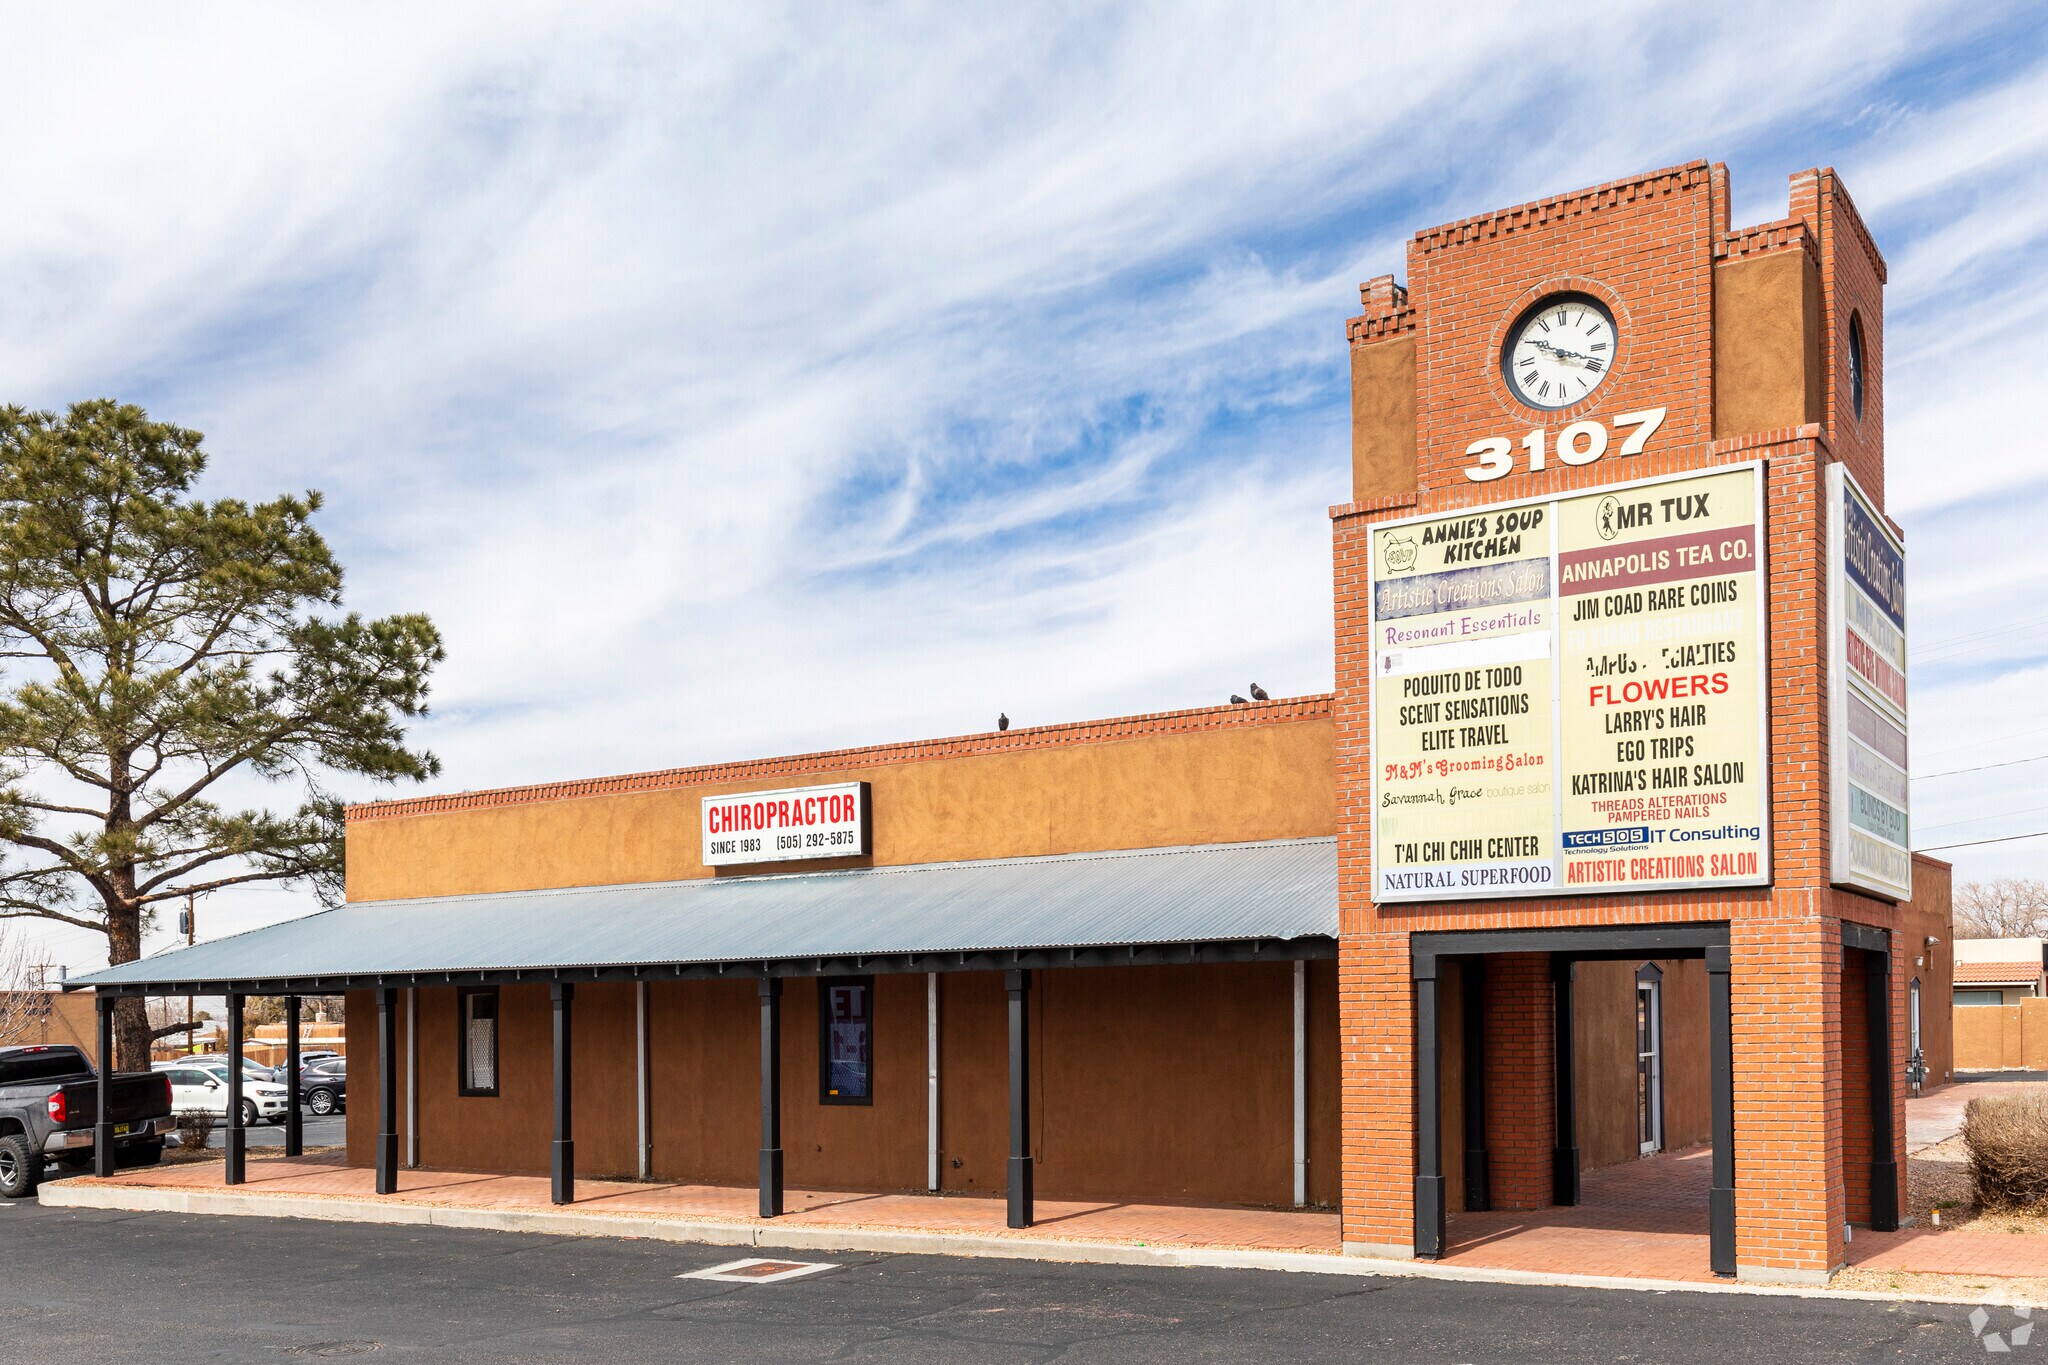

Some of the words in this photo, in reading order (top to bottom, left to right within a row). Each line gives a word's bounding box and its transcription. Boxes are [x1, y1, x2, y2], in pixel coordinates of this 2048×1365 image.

[1464, 407, 1667, 482] 3107
[1617, 502, 1653, 530] MR
[1660, 493, 1710, 522] TUX
[1422, 517, 1488, 546] ANNIE'S
[1495, 509, 1544, 536] SOUP
[1443, 535, 1521, 564] KITCHEN
[1562, 550, 1670, 583] ANNAPOLIS
[1676, 544, 1713, 567] TEA
[1720, 539, 1752, 562] CO.
[1380, 583, 1433, 613] Artistic
[1437, 578, 1502, 605] Creations
[1506, 564, 1546, 597] Salon
[1573, 598, 1599, 621] JIM
[1604, 592, 1643, 617] COAD
[1648, 587, 1685, 611] RARE
[1690, 580, 1737, 607] COINS
[1385, 620, 1455, 645] Resonant
[1460, 609, 1541, 635] Essentials
[1404, 672, 1461, 698] POQUITO
[1465, 670, 1481, 691] DE
[1485, 665, 1522, 689] TODO
[1590, 672, 1729, 706] FLOWERS
[1400, 702, 1441, 726] SCENT
[1445, 693, 1529, 722] SENSATIONS
[1605, 708, 1664, 734] LARRY'S
[1670, 704, 1706, 728] HAIR
[1422, 729, 1455, 751] ELITE
[1460, 724, 1509, 748] TRAVEL
[1617, 740, 1645, 762] EGO
[1650, 735, 1694, 759] TRIPS
[1385, 759, 1433, 782] M&M's
[1572, 769, 1646, 796] KATRINA'S
[1652, 766, 1688, 789] HAIR
[1693, 761, 1744, 786] SALON
[1382, 789, 1445, 808] Savannah
[1449, 786, 1483, 805] Grace
[1486, 784, 1525, 798] boutique
[1527, 782, 1551, 795] salon
[1592, 798, 1644, 812] THREADS
[1648, 792, 1727, 809] ALTERATIONS
[709, 794, 855, 834] CHIROPRACTOR
[1608, 808, 1670, 823] PAMPERED
[1675, 806, 1710, 819] NAILS
[711, 840, 736, 855] SINCE
[740, 838, 761, 852] 1983
[777, 834, 802, 851] (505)
[806, 831, 854, 848] 292-5875
[1395, 843, 1418, 863] T'AI
[1423, 841, 1445, 862] CHI
[1450, 839, 1483, 861] CHIH
[1487, 836, 1539, 859] CENTER
[1609, 844, 1649, 852] Solutions
[1650, 829, 1666, 844] IT
[1669, 825, 1760, 841] Consulting
[1385, 871, 1456, 890] NATURAL
[1461, 865, 1552, 886] SUPERFOOD
[1567, 859, 1626, 884] ARTISTIC
[1631, 855, 1704, 880] CREATIONS
[1711, 852, 1757, 877] SALON
